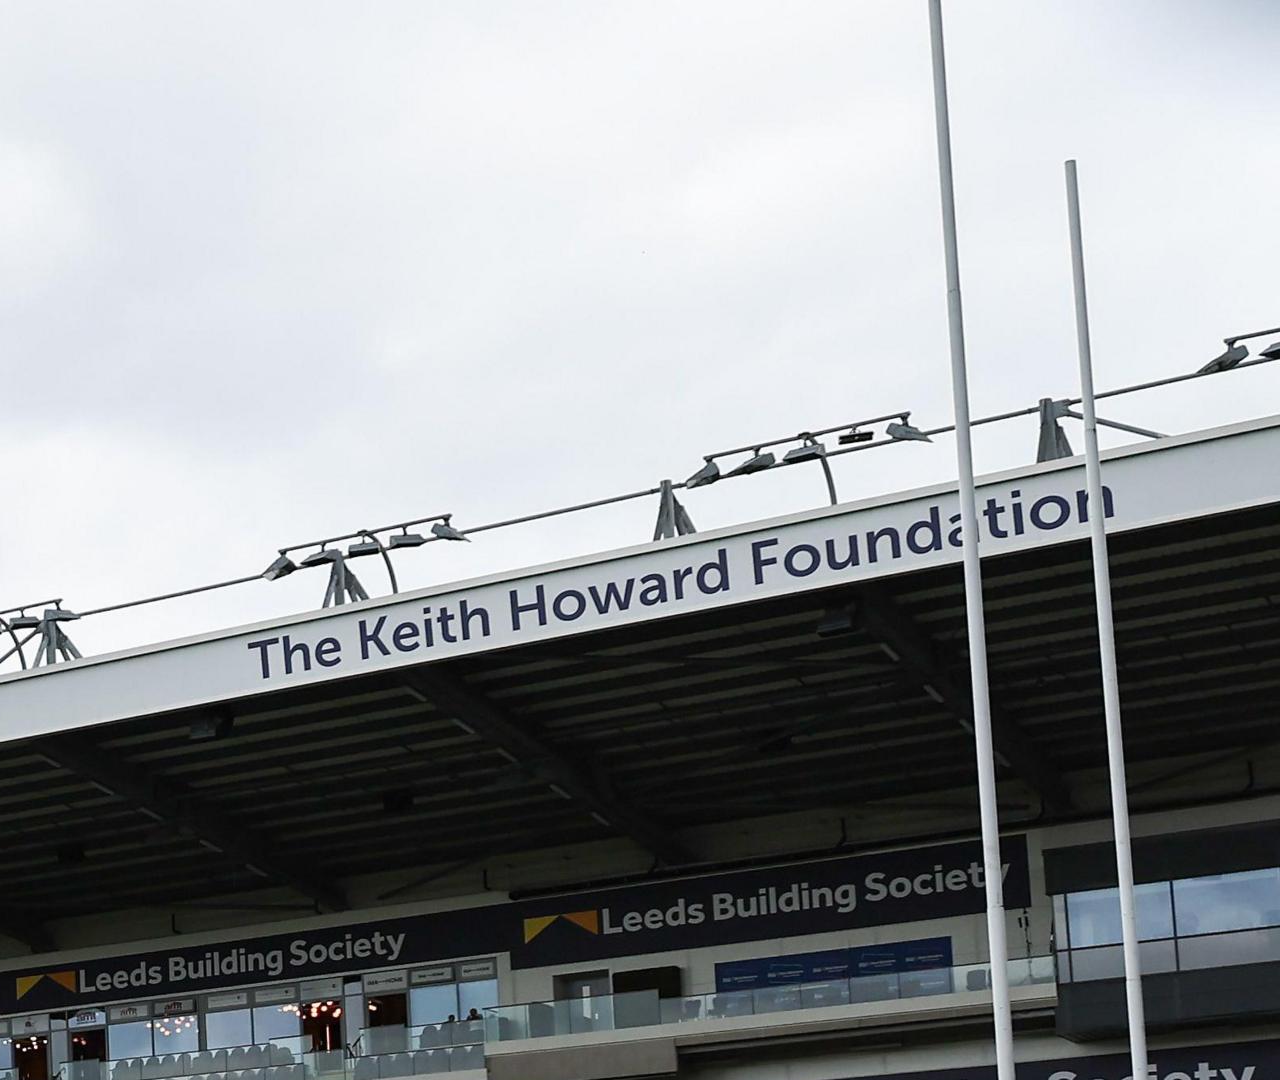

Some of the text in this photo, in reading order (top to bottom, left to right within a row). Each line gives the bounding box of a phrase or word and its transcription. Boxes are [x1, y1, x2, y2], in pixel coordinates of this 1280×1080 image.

[247, 483, 1115, 679] The Keith Howard Foundation
[601, 898, 706, 935] Leeds
[713, 882, 856, 921] Building
[79, 931, 406, 994] Leeds Building Society
